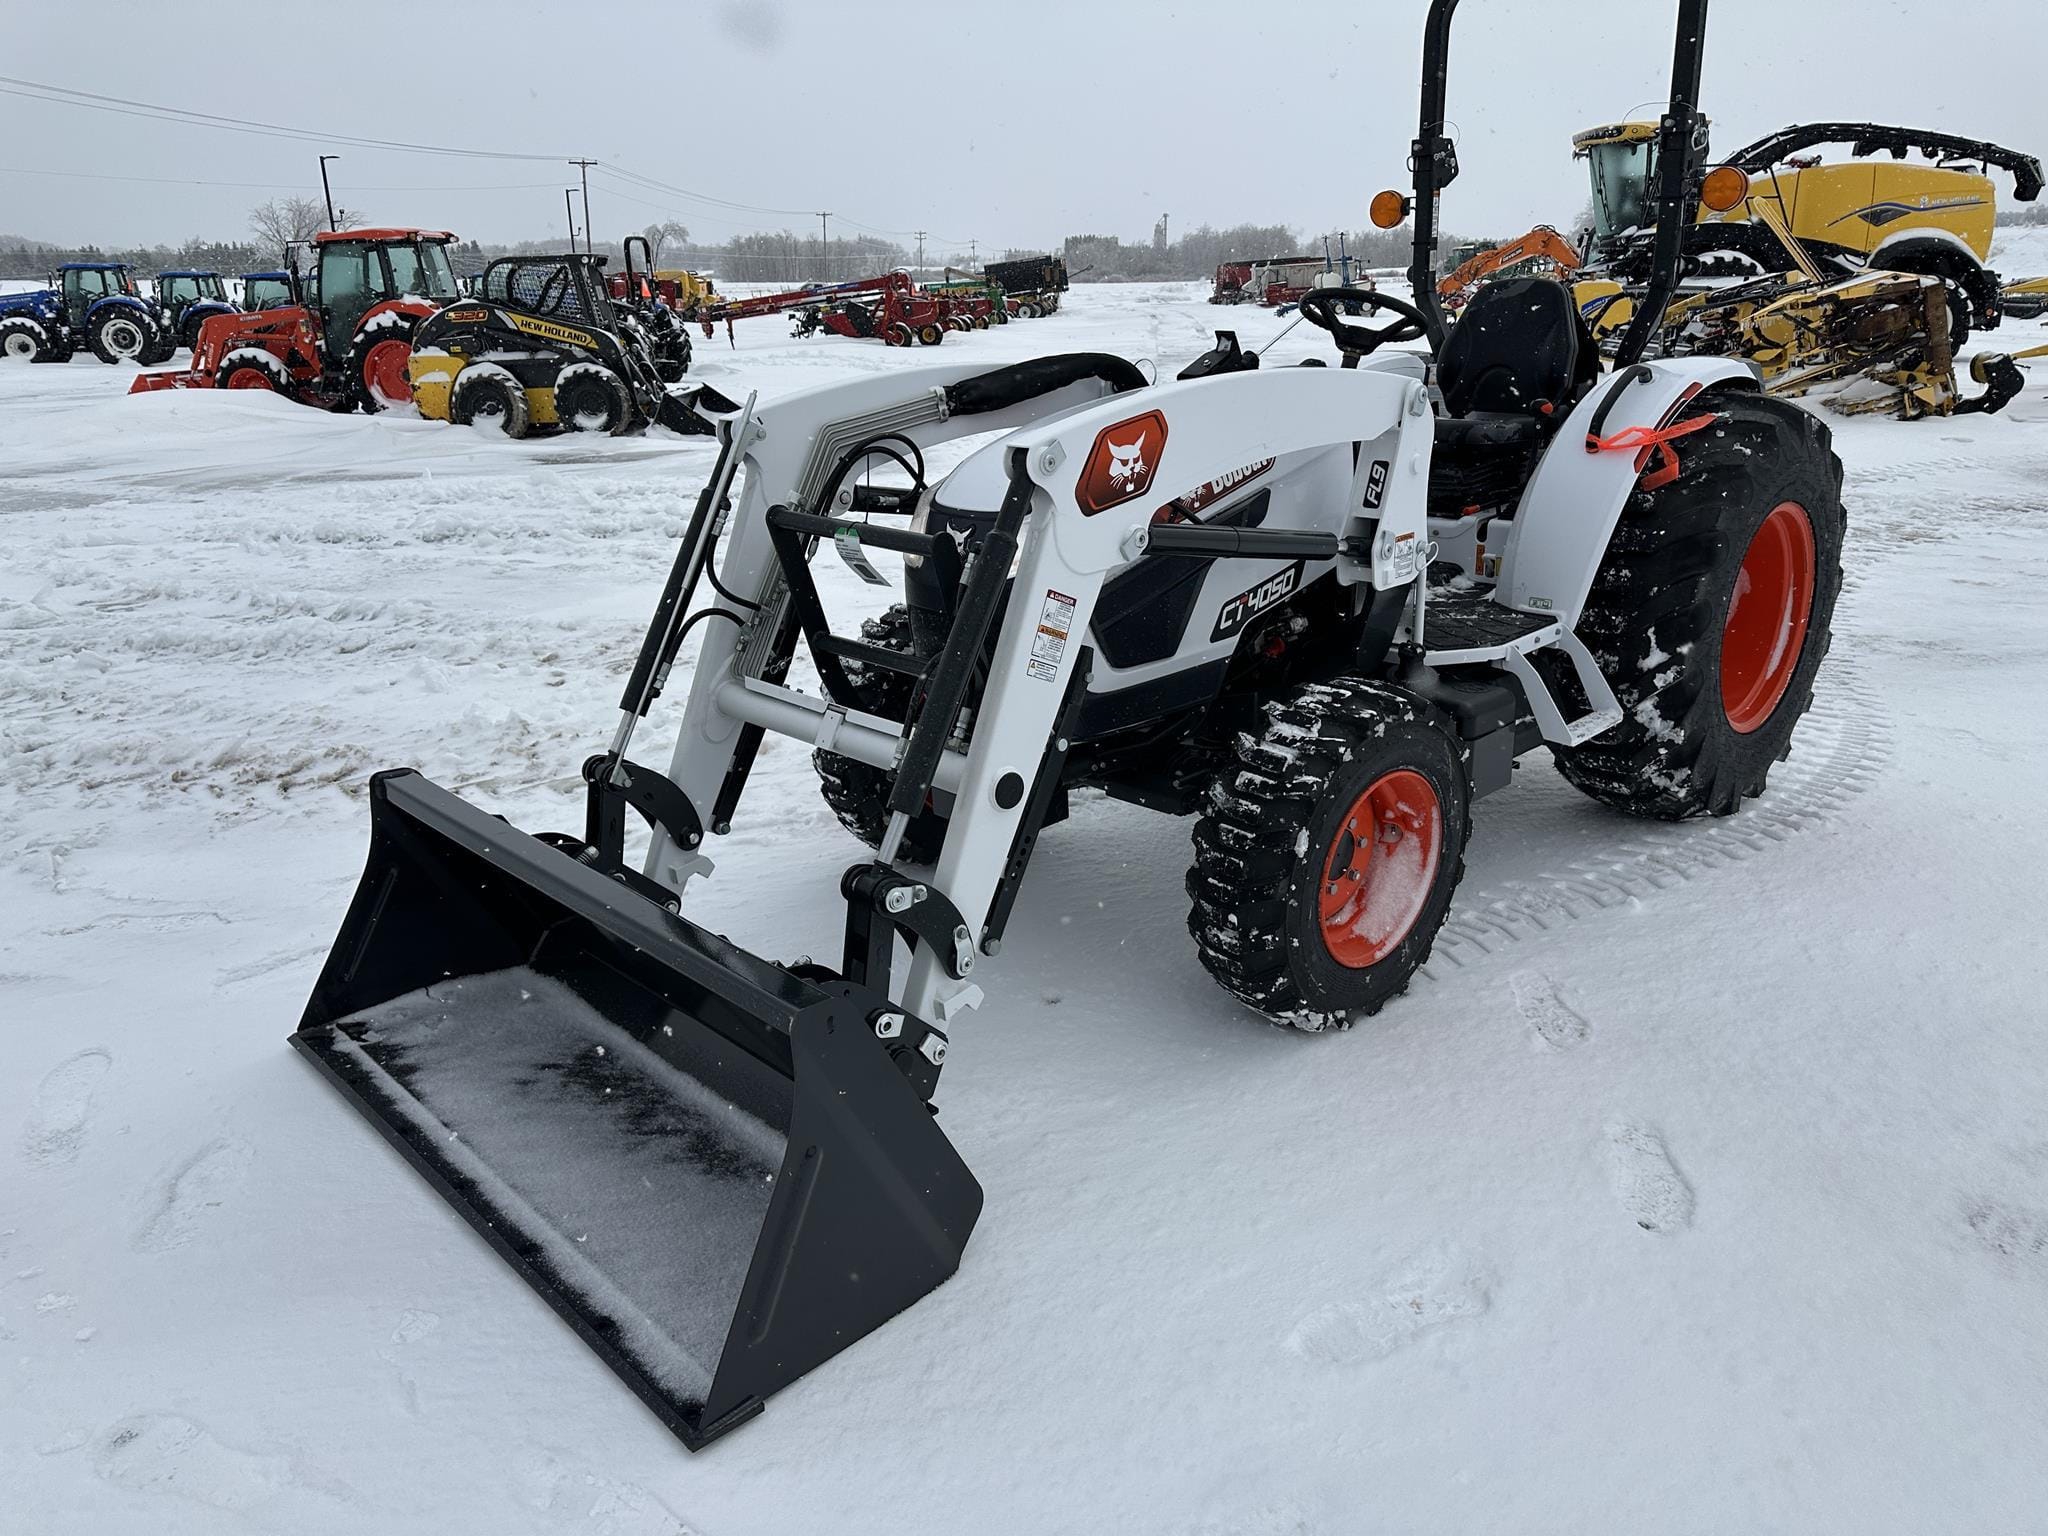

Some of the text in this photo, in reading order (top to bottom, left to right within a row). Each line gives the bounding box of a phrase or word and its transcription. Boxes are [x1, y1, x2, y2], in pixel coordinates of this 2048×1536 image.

[445, 309, 488, 322] L320
[521, 319, 587, 344] NEW HOLLAND
[1366, 463, 1386, 506] FL9
[1054, 593, 1075, 605] DANGER
